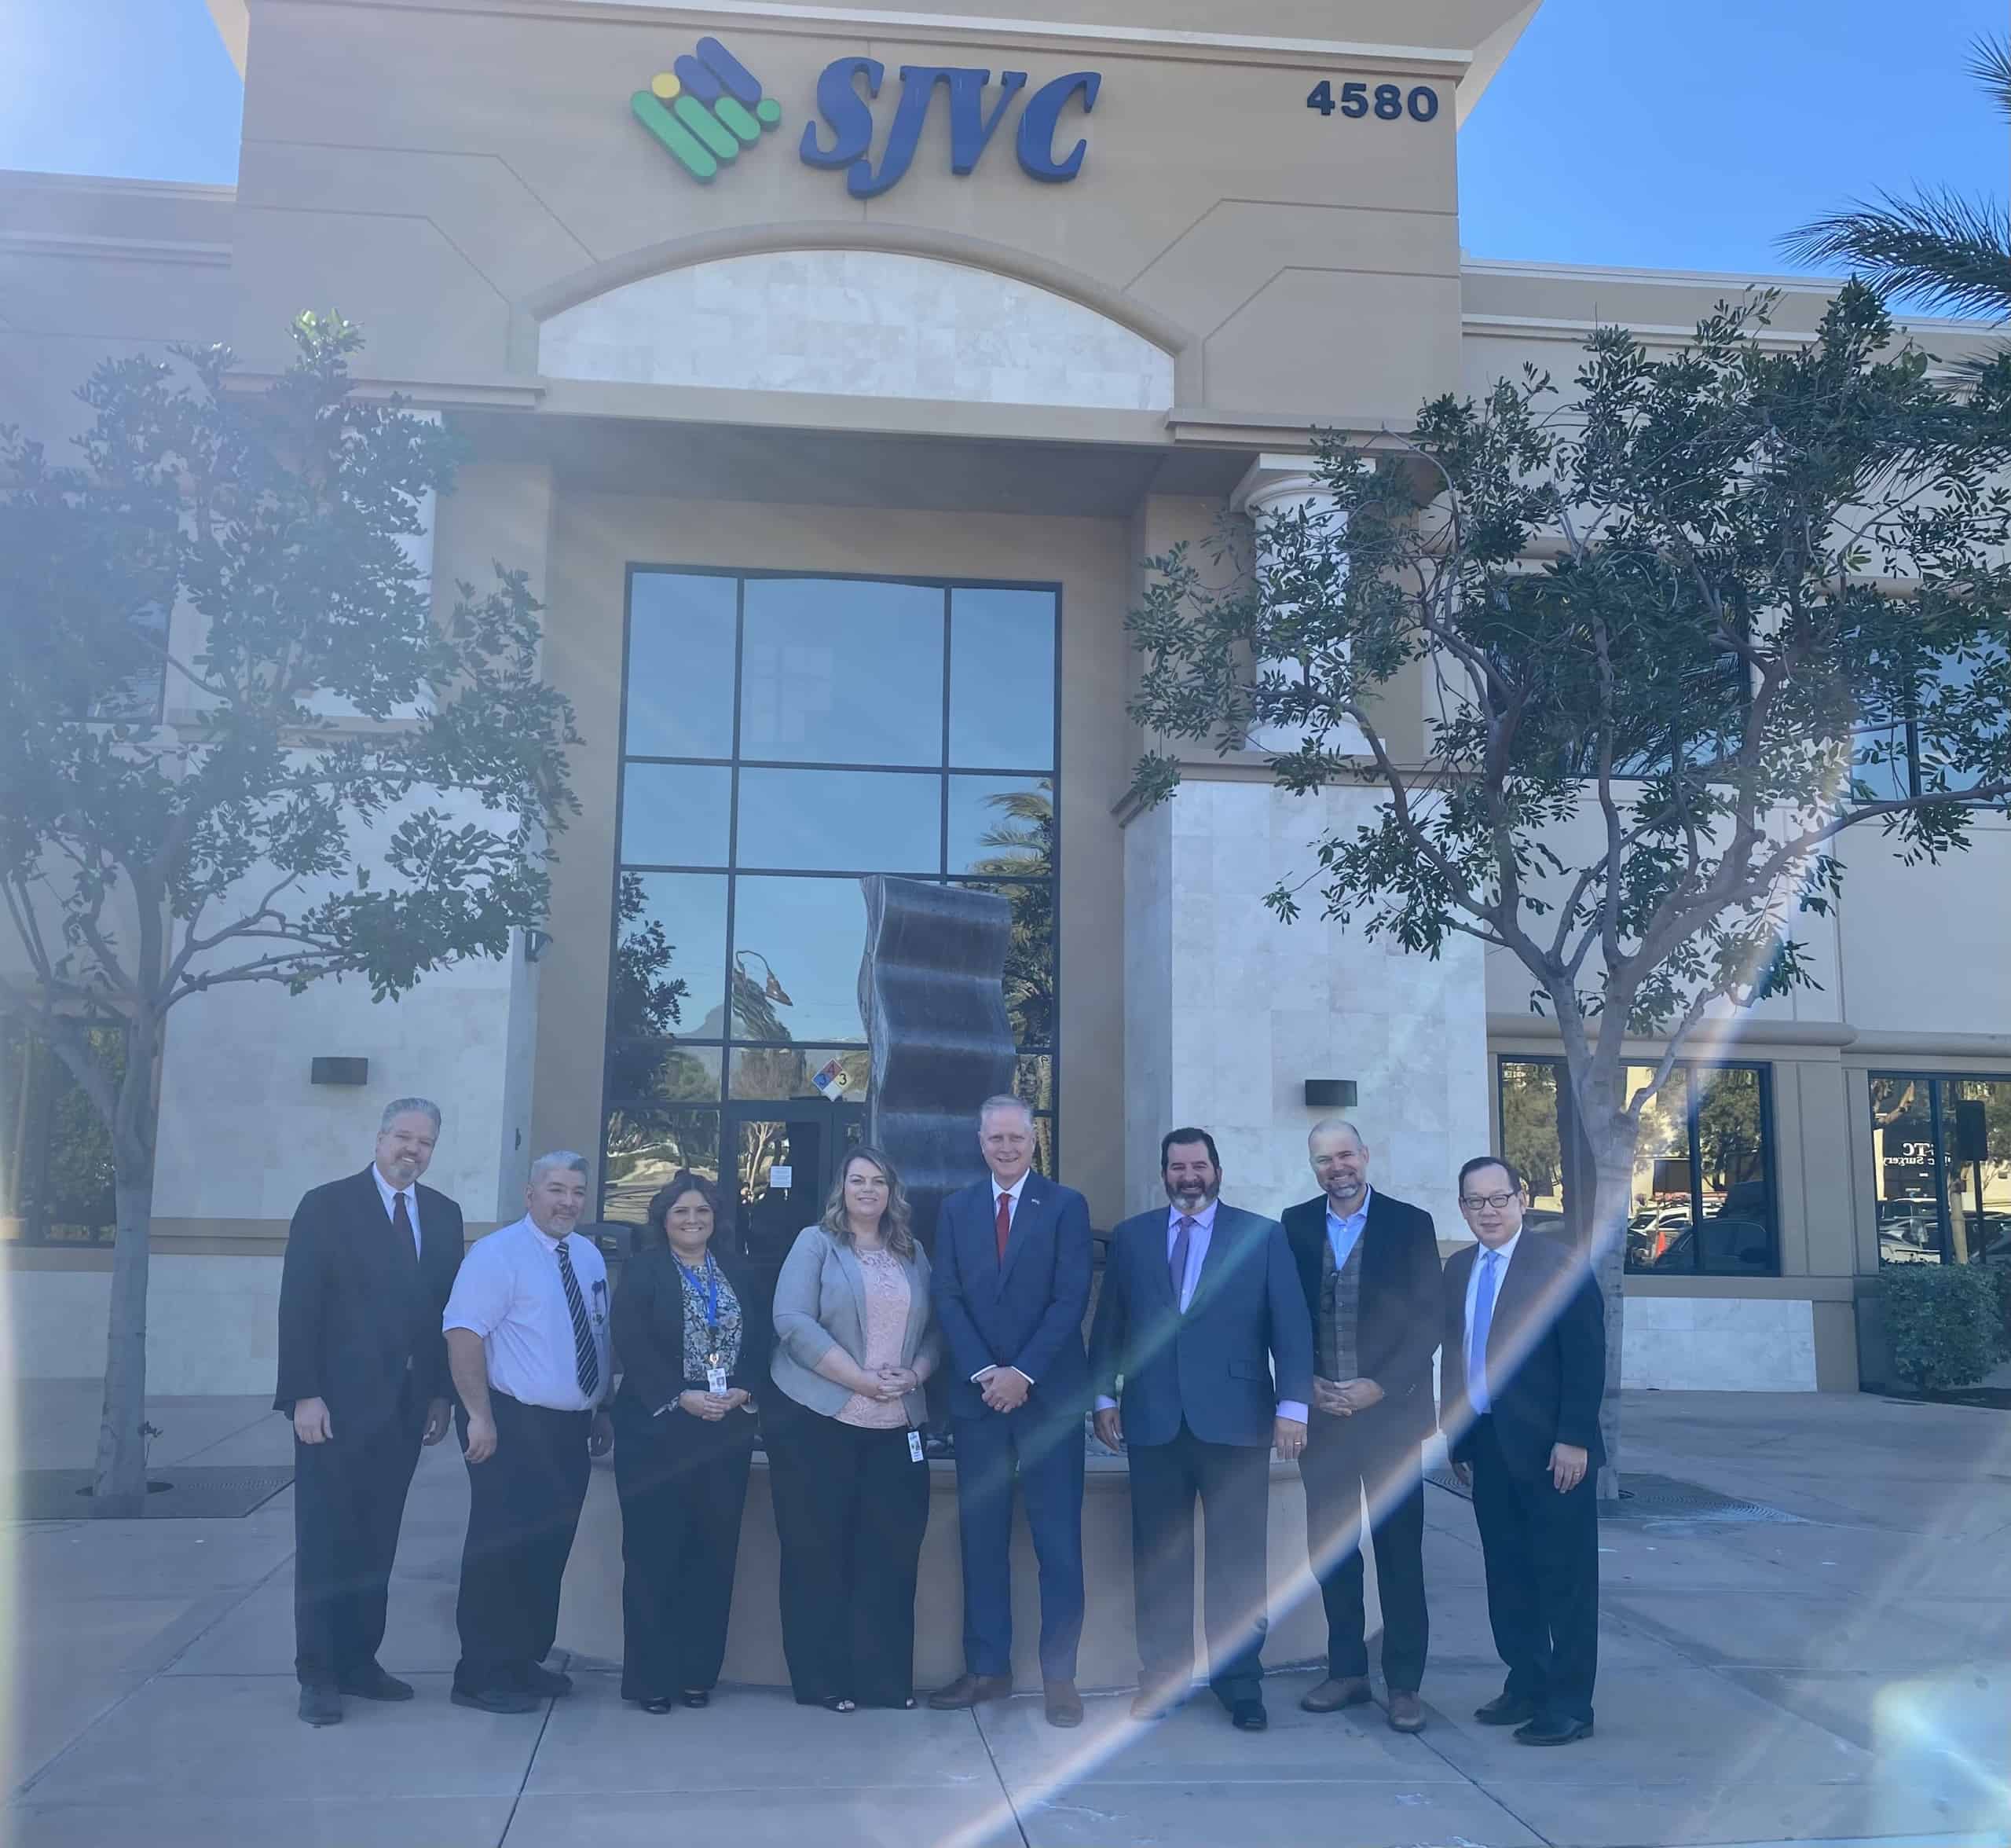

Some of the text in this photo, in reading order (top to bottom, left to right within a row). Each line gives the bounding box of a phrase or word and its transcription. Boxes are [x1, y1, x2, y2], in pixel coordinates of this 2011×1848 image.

[1306, 80, 1438, 122] 4580
[799, 57, 1101, 200] SJVC
[839, 1073, 847, 1086] 3
